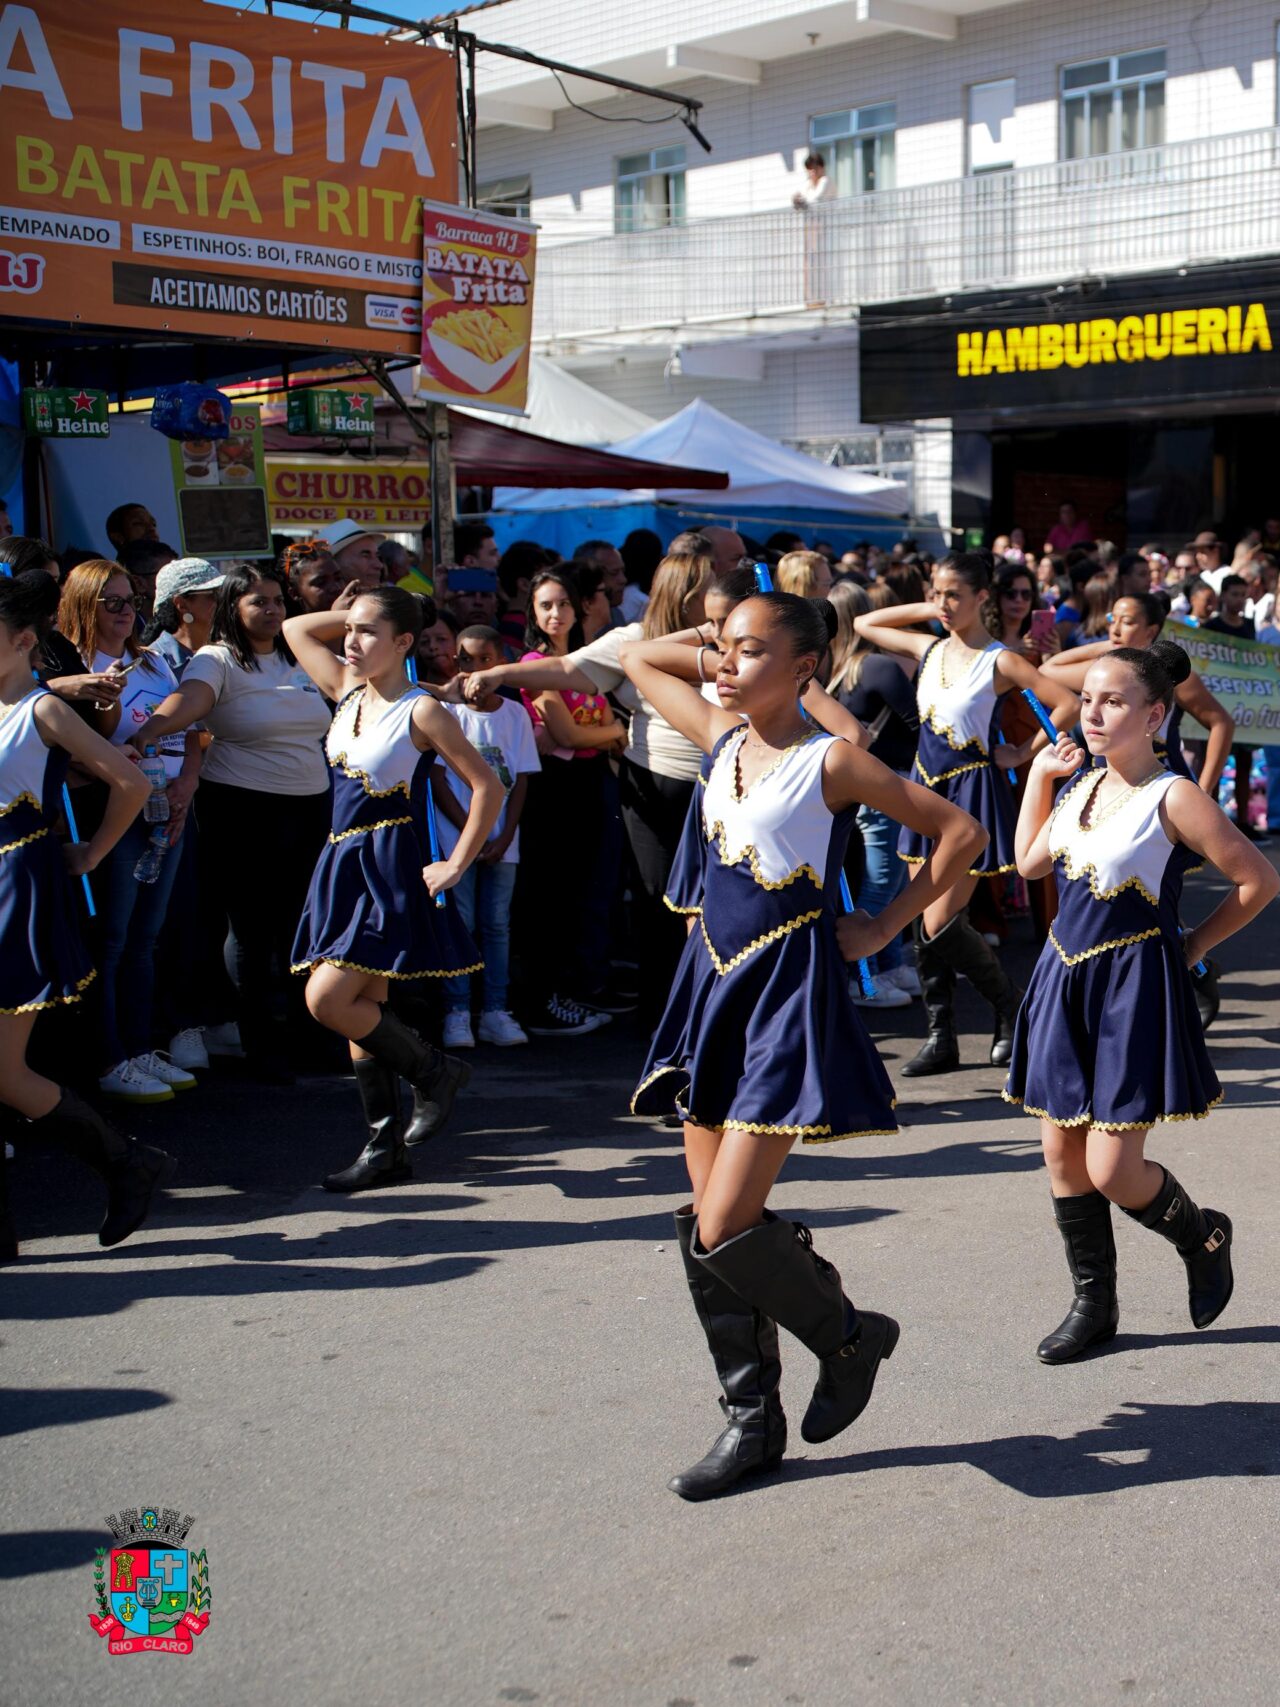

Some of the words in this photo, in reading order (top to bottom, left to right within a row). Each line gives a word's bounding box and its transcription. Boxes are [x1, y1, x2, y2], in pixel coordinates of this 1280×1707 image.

[118, 28, 436, 178] FRITA
[16, 135, 263, 224] BATATA
[1, 216, 110, 243] EMPANADO
[436, 222, 493, 245] Barraca
[496, 231, 519, 253] HJ
[143, 231, 252, 258] ESPETINHOS:
[257, 245, 290, 264] BOI,
[295, 250, 359, 271] FRANGO
[364, 258, 372, 272] E
[427, 247, 529, 282] BATATA
[150, 277, 260, 313] ACEITAMOS
[266, 290, 348, 323] CARTÕES
[452, 277, 527, 303] Frita
[374, 308, 395, 318] VISA
[957, 304, 1272, 376] HAMBURGUERIA
[57, 418, 109, 433] Heine
[275, 507, 337, 520] DOCE
[346, 508, 376, 521] DE
[385, 509, 431, 521] LEIT
[1200, 673, 1273, 695] eservar
[1233, 702, 1254, 726] do
